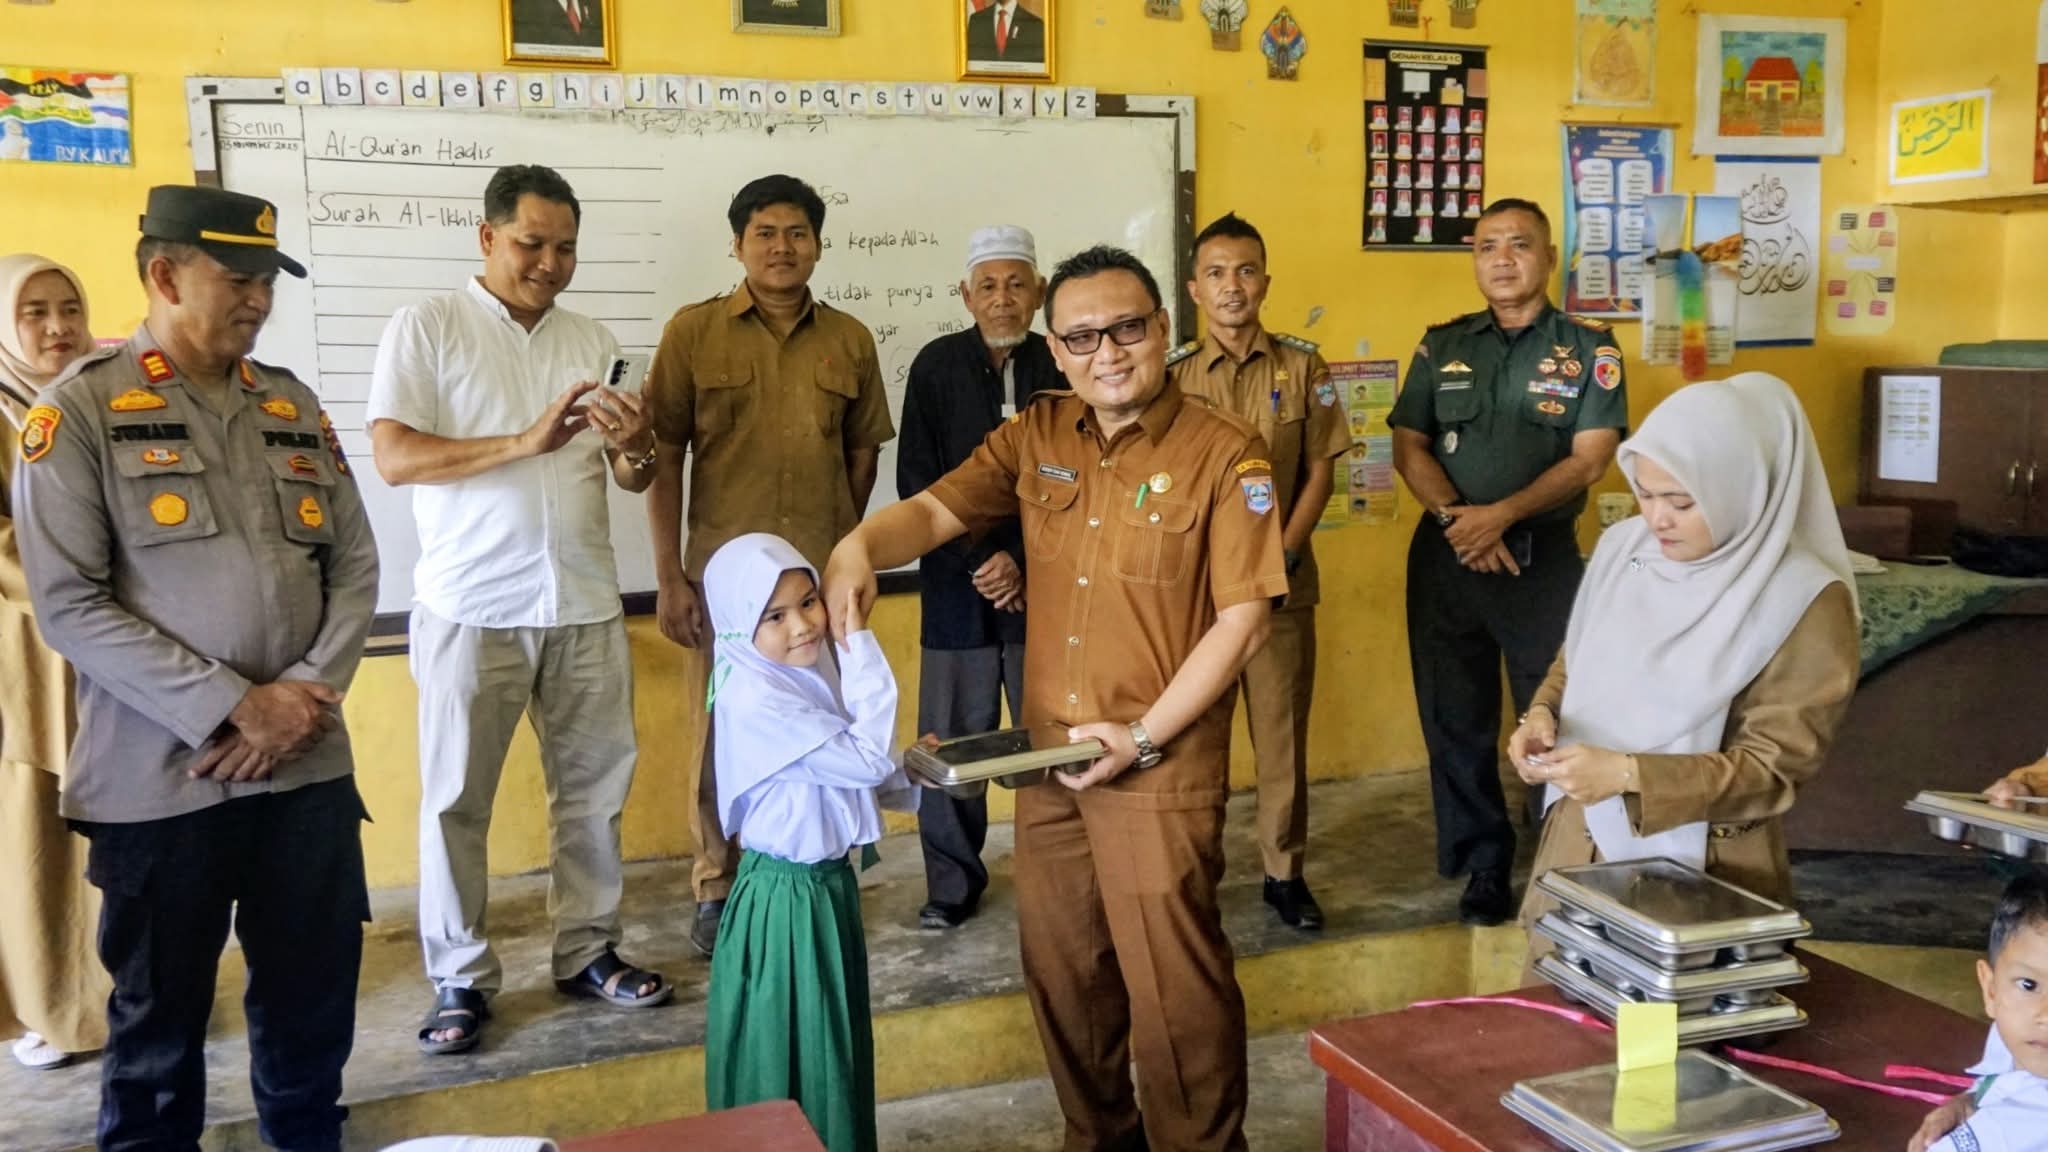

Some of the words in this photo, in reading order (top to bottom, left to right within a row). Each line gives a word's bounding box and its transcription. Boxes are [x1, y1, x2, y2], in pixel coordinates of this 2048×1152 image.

[295, 80, 310, 94] a
[336, 73, 351, 96] b
[375, 81, 389, 95] c
[412, 75, 426, 99] d
[454, 83, 467, 97] e
[493, 79, 507, 102] f
[529, 82, 543, 102] g
[564, 78, 577, 100] h
[666, 82, 677, 104] k
[719, 87, 739, 101] m
[750, 90, 761, 104] n
[774, 91, 787, 103] o
[800, 89, 812, 106] p
[823, 89, 839, 108] q
[850, 91, 861, 104] r
[876, 89, 887, 104] s
[904, 88, 914, 107] t
[931, 92, 943, 106] u
[959, 94, 970, 107] v
[976, 95, 993, 108] w
[1013, 96, 1023, 110] x
[1044, 95, 1056, 113] y
[1075, 95, 1087, 108] z
[221, 113, 285, 137] Senin
[437, 138, 494, 160] Hadis
[313, 193, 380, 223] Surah
[399, 201, 483, 226] Al-Ikhla
[848, 231, 897, 256] kepada
[900, 228, 940, 248] Allah
[824, 281, 873, 301] tidak
[887, 286, 933, 307] punya
